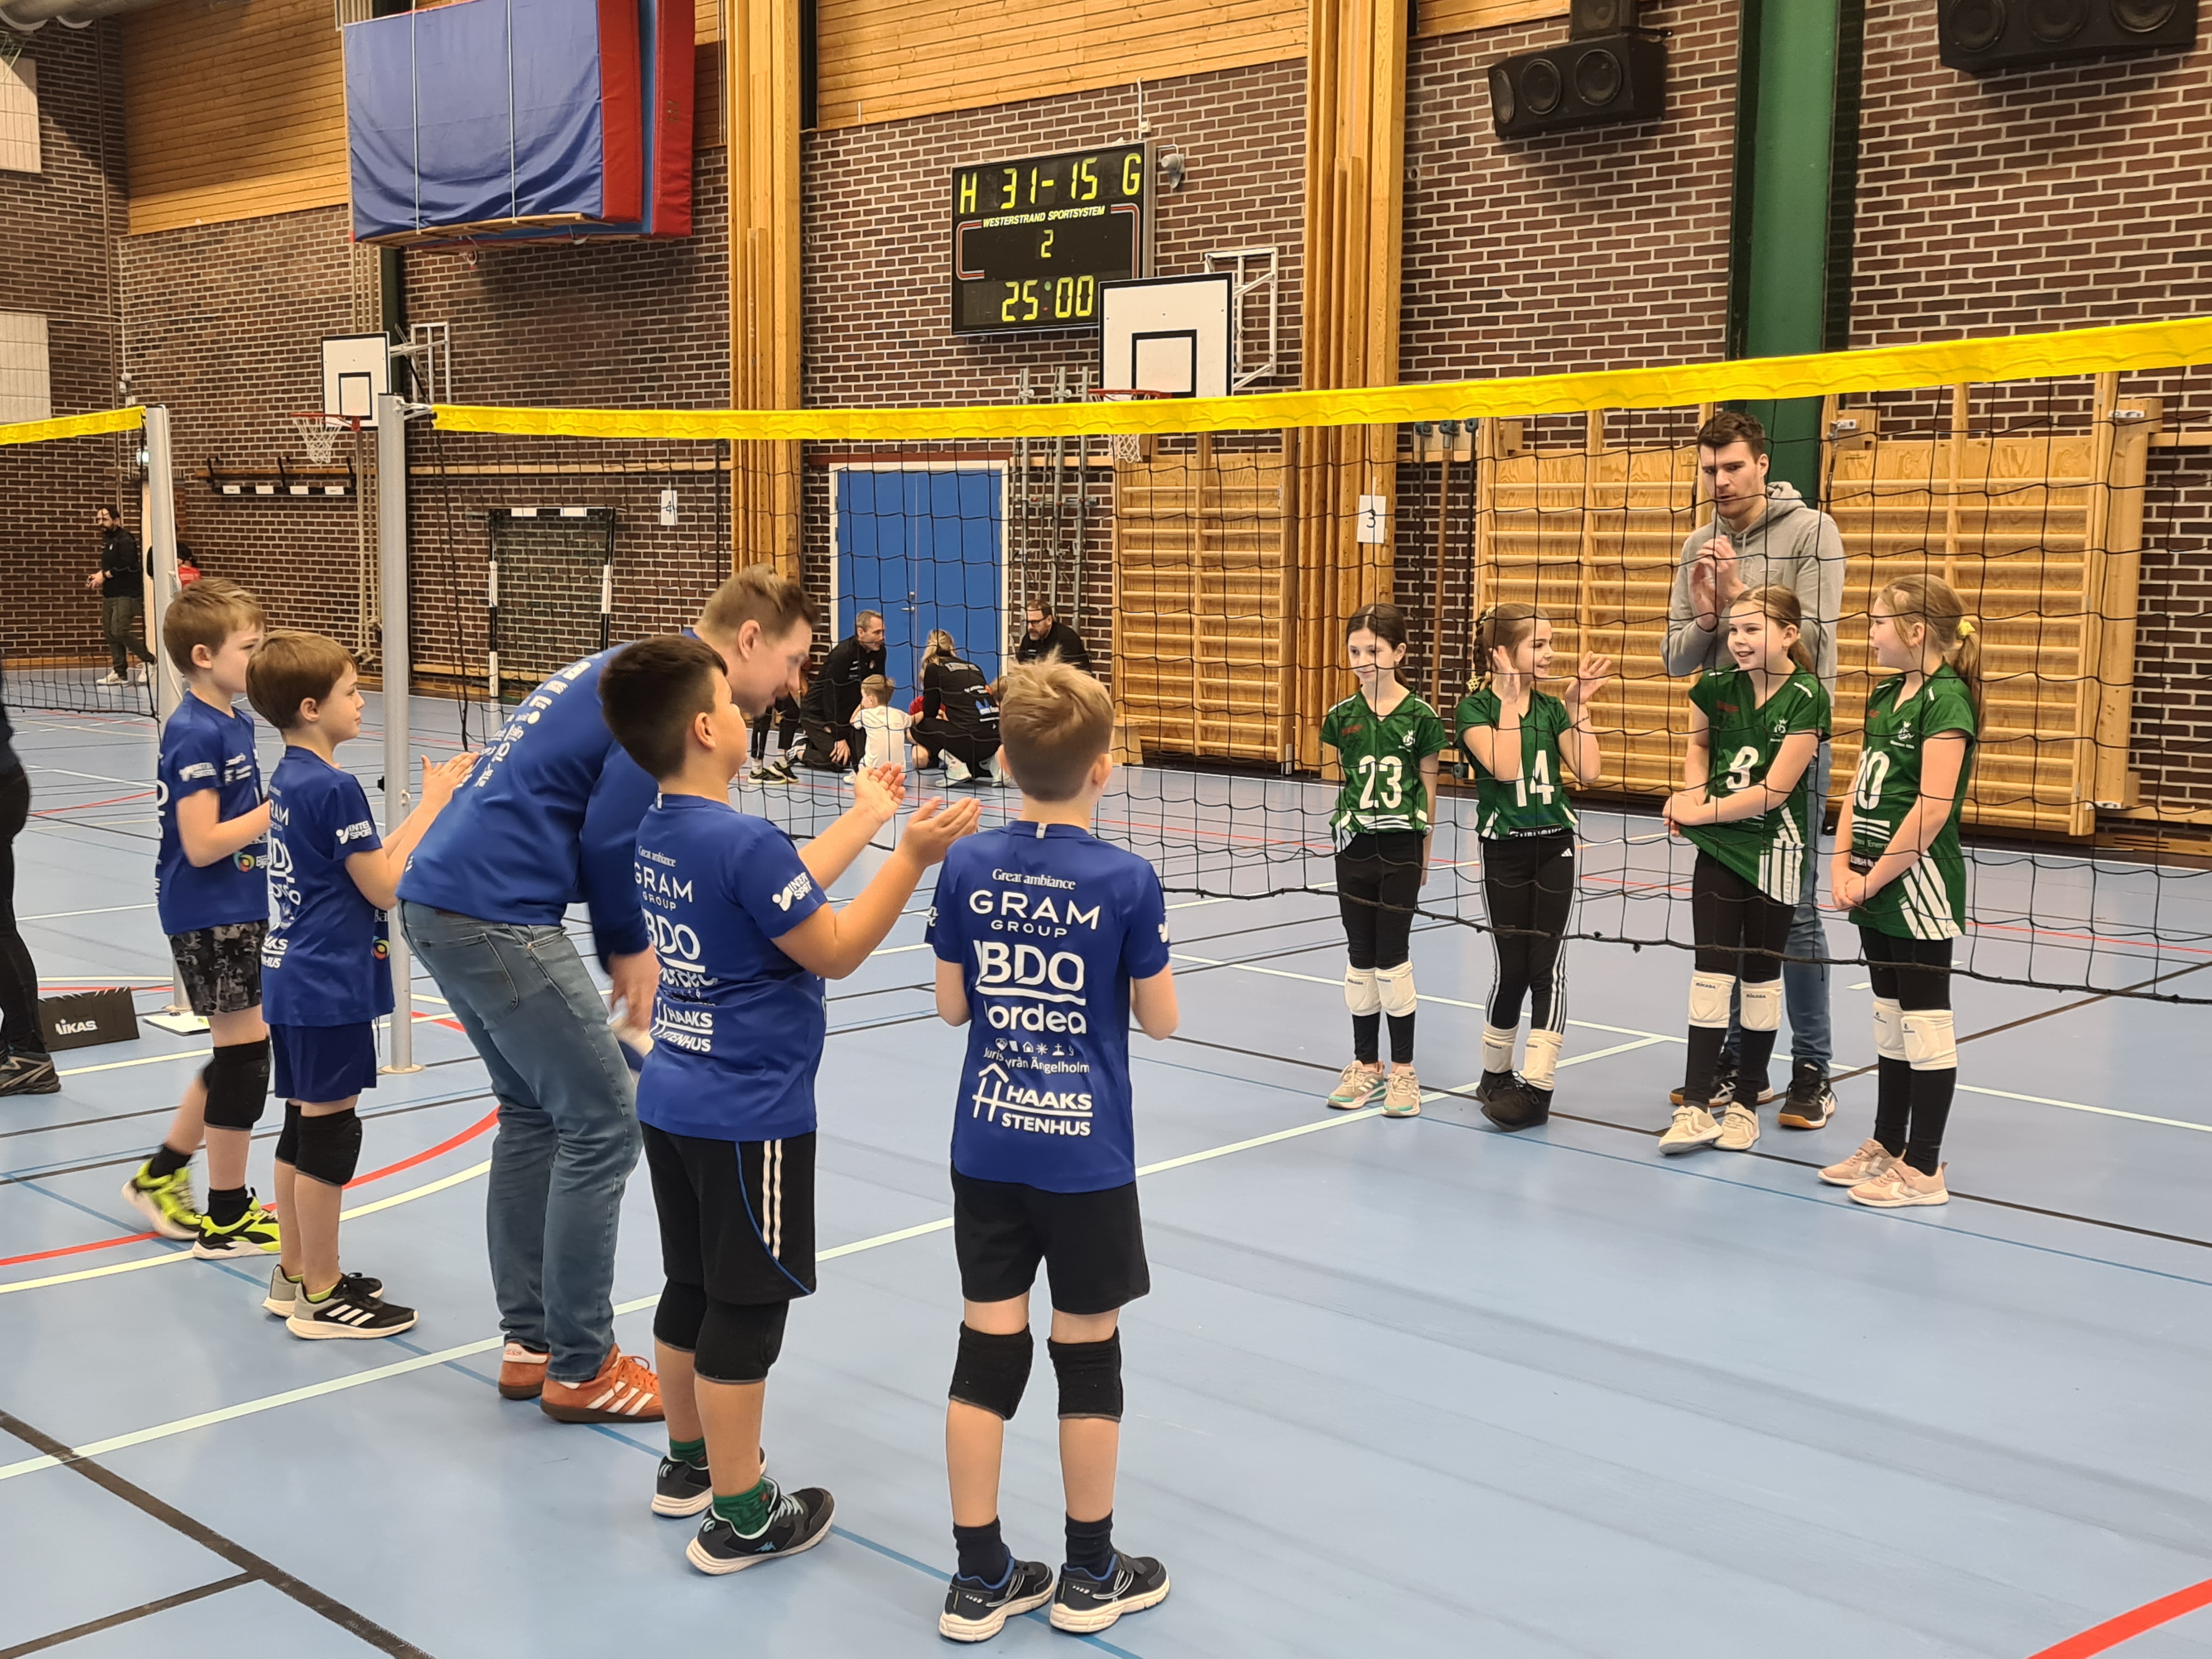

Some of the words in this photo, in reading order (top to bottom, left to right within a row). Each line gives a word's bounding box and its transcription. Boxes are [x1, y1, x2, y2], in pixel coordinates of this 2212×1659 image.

[960, 172, 977, 213] H
[1122, 153, 1142, 196] G
[983, 212, 1046, 228] WESTERSTRAND
[1047, 205, 1105, 221] SPORTSYSTEM
[1041, 229, 1054, 257] 2
[1366, 509, 1375, 528] 3
[1358, 755, 1403, 810] 23
[1515, 749, 1555, 808] 14
[1853, 746, 1890, 810] 10
[634, 861, 693, 903] GRAM
[992, 868, 1022, 883] Great
[1023, 874, 1077, 890] ambiance
[642, 891, 676, 911] GROUP
[969, 889, 1101, 930] GRAM
[990, 919, 1068, 938] GROUP
[979, 940, 1085, 992] BDO
[667, 1007, 713, 1028] HAAKS
[983, 1000, 1087, 1034] ordea
[1030, 1056, 1090, 1074] Ängelholm
[1006, 1085, 1092, 1110] HAAKS
[1001, 1112, 1091, 1136] STENHUS
